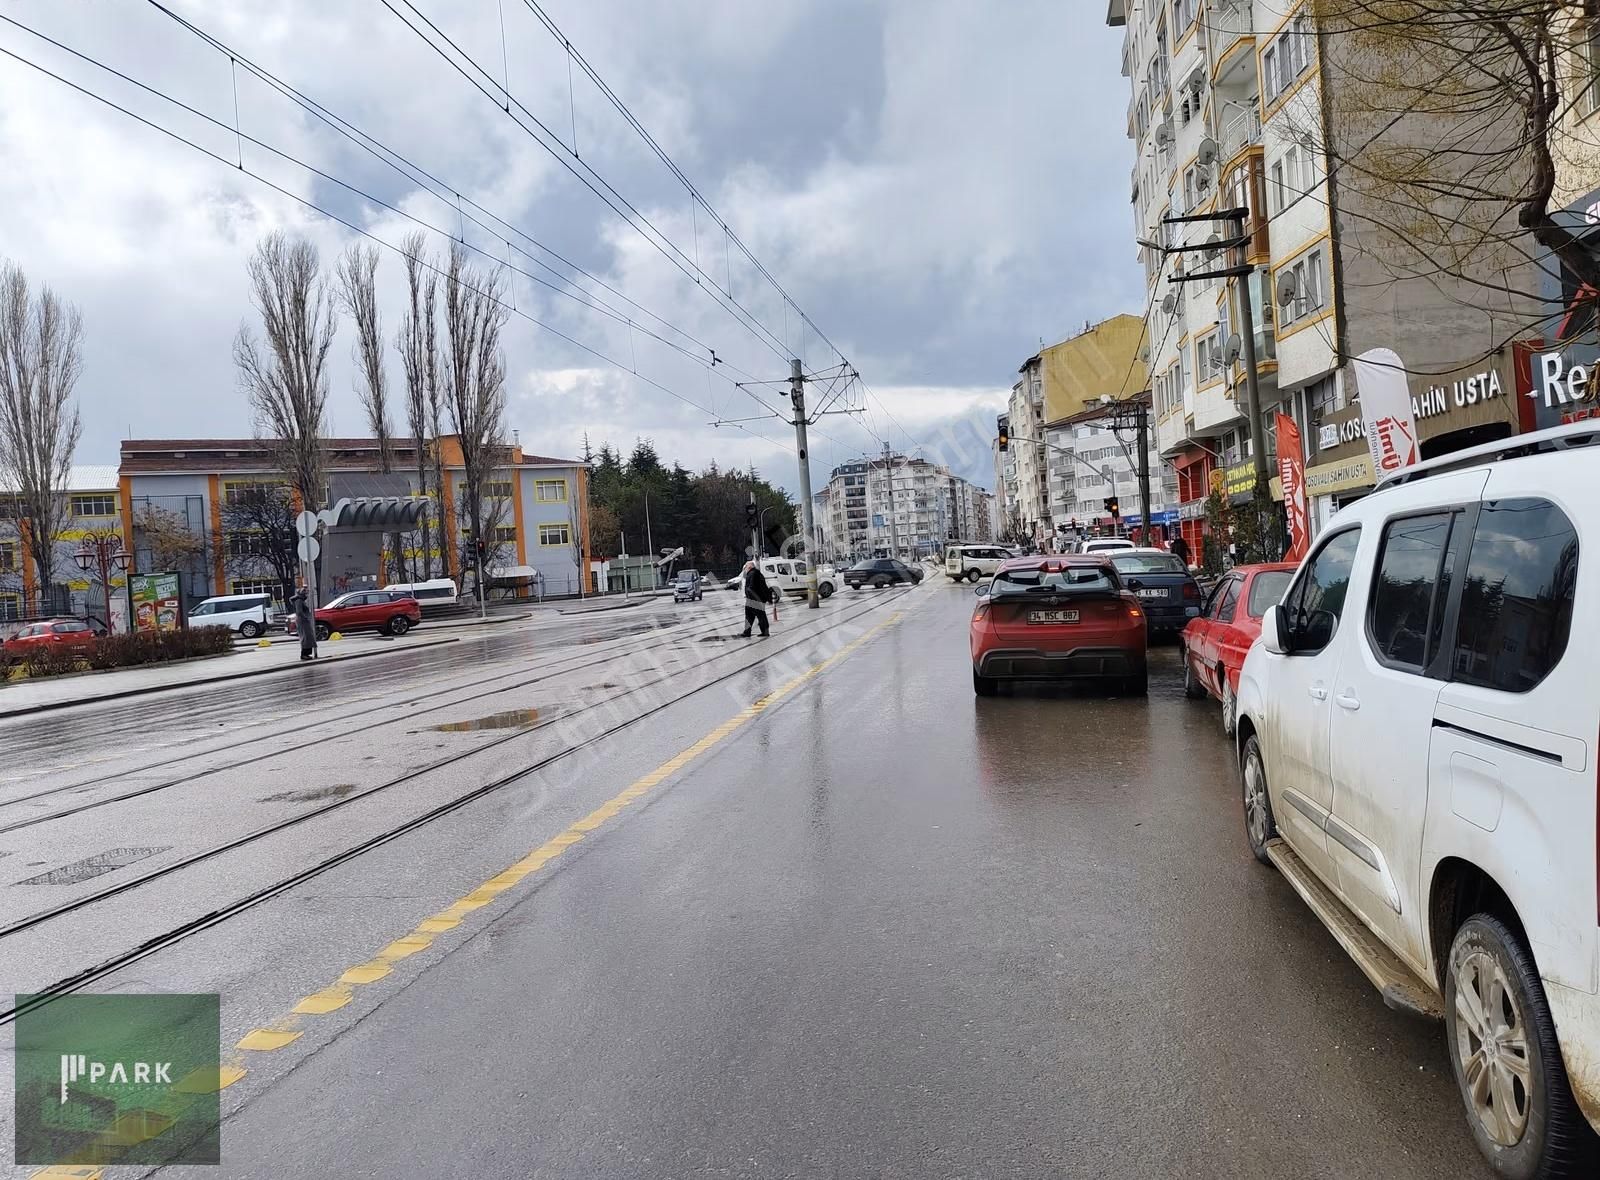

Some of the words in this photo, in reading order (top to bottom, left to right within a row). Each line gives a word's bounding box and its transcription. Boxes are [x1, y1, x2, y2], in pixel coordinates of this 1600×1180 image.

[1412, 386, 1447, 418] AHİN
[1454, 368, 1502, 407] USTA
[1031, 612, 1041, 621] 34
